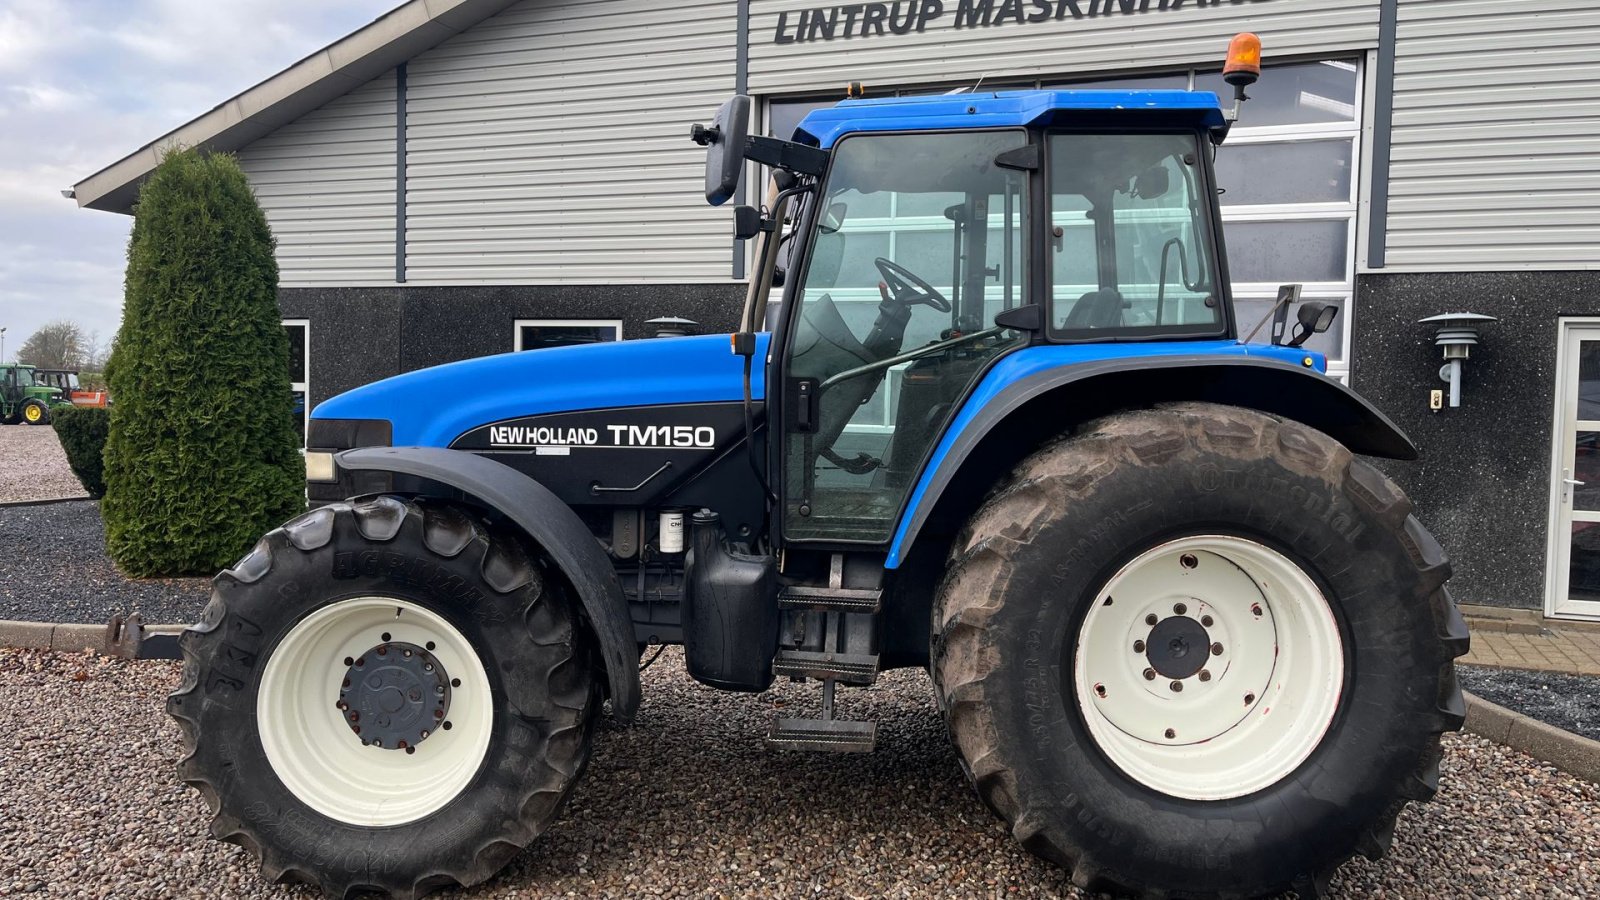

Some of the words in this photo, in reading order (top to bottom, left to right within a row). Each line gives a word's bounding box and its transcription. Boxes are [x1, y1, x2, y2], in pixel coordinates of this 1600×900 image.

[774, 0, 943, 44] LINTRUP
[490, 427, 524, 443] NEW
[526, 427, 598, 445] HOLLAND
[606, 424, 715, 447] TM150
